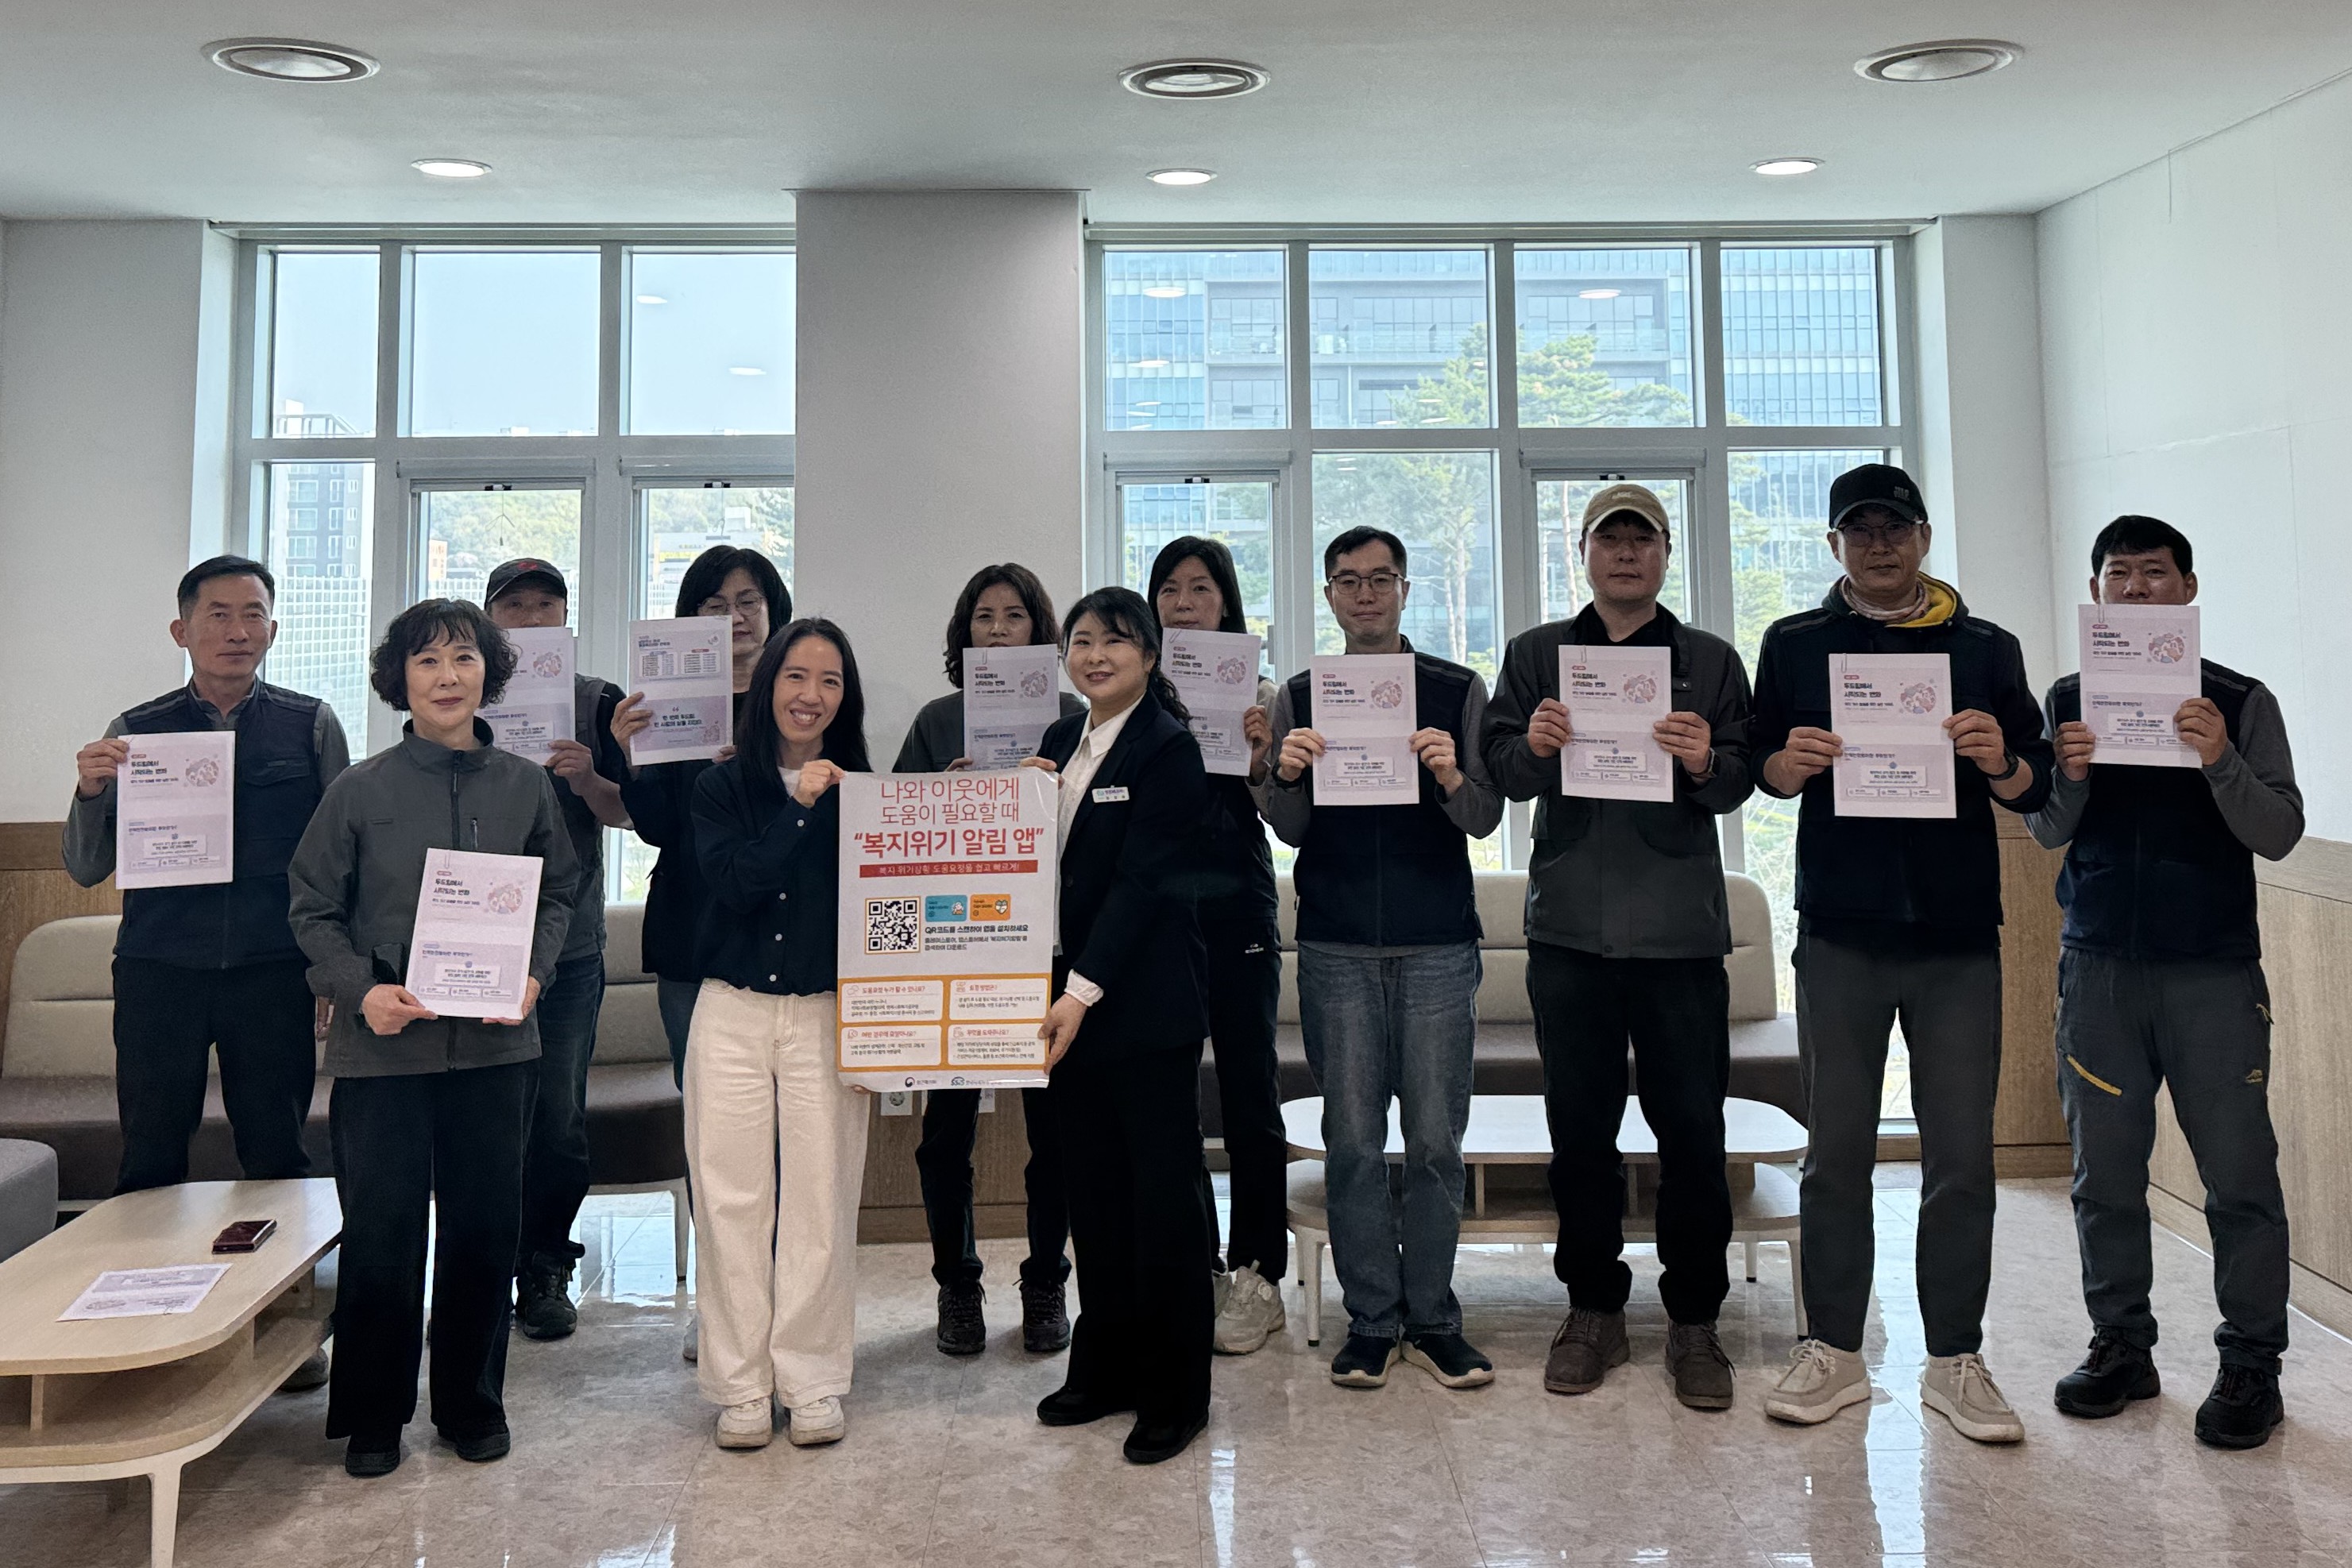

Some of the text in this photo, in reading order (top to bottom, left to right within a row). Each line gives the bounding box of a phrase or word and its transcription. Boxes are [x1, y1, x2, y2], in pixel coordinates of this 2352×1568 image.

[881, 777, 1019, 803] 나와 이웃에게
[880, 801, 1019, 825] 도움이 필요할 때
[854, 827, 1044, 858] “복지위기 알림 앱”
[933, 864, 973, 874] 도움요청을
[975, 863, 991, 873] 쉽고
[925, 925, 956, 934] QR코드를
